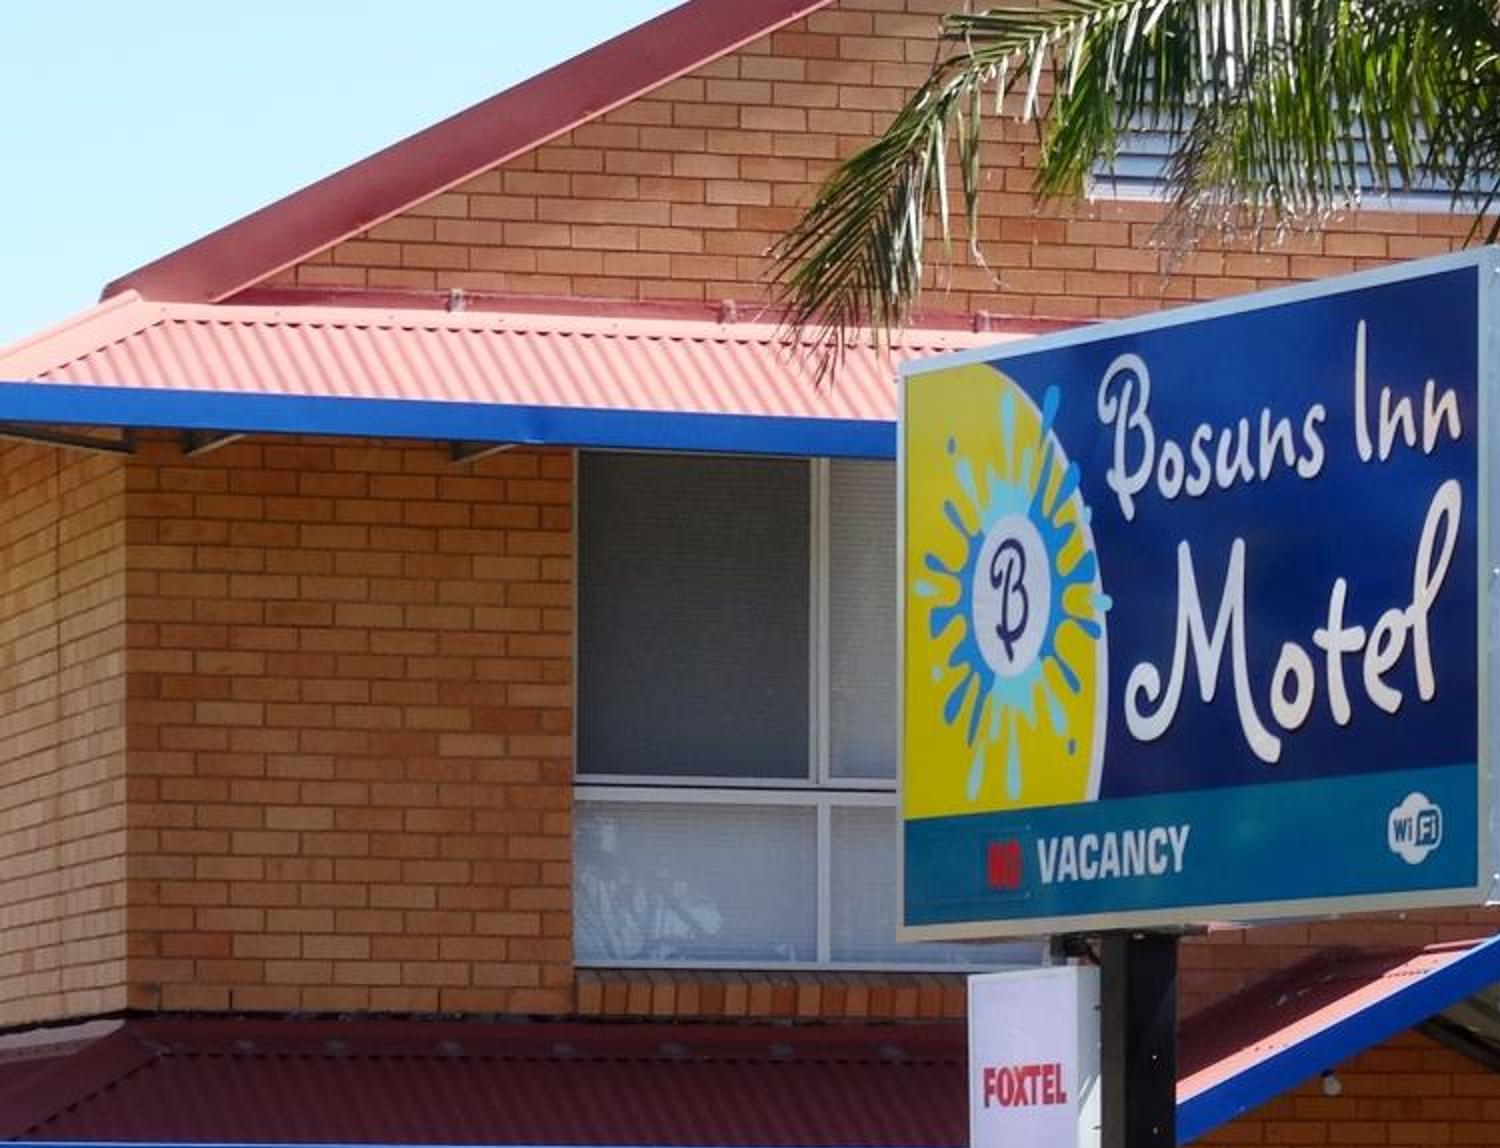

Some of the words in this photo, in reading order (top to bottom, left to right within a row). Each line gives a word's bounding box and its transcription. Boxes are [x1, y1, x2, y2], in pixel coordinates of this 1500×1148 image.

[1097, 353, 1326, 521] Bosuns
[1354, 319, 1461, 462] Inn
[989, 537, 1029, 663] B
[1124, 479, 1462, 763] Motel
[1036, 824, 1190, 884] VACANCY
[983, 1063, 1067, 1108] FOXTEL
